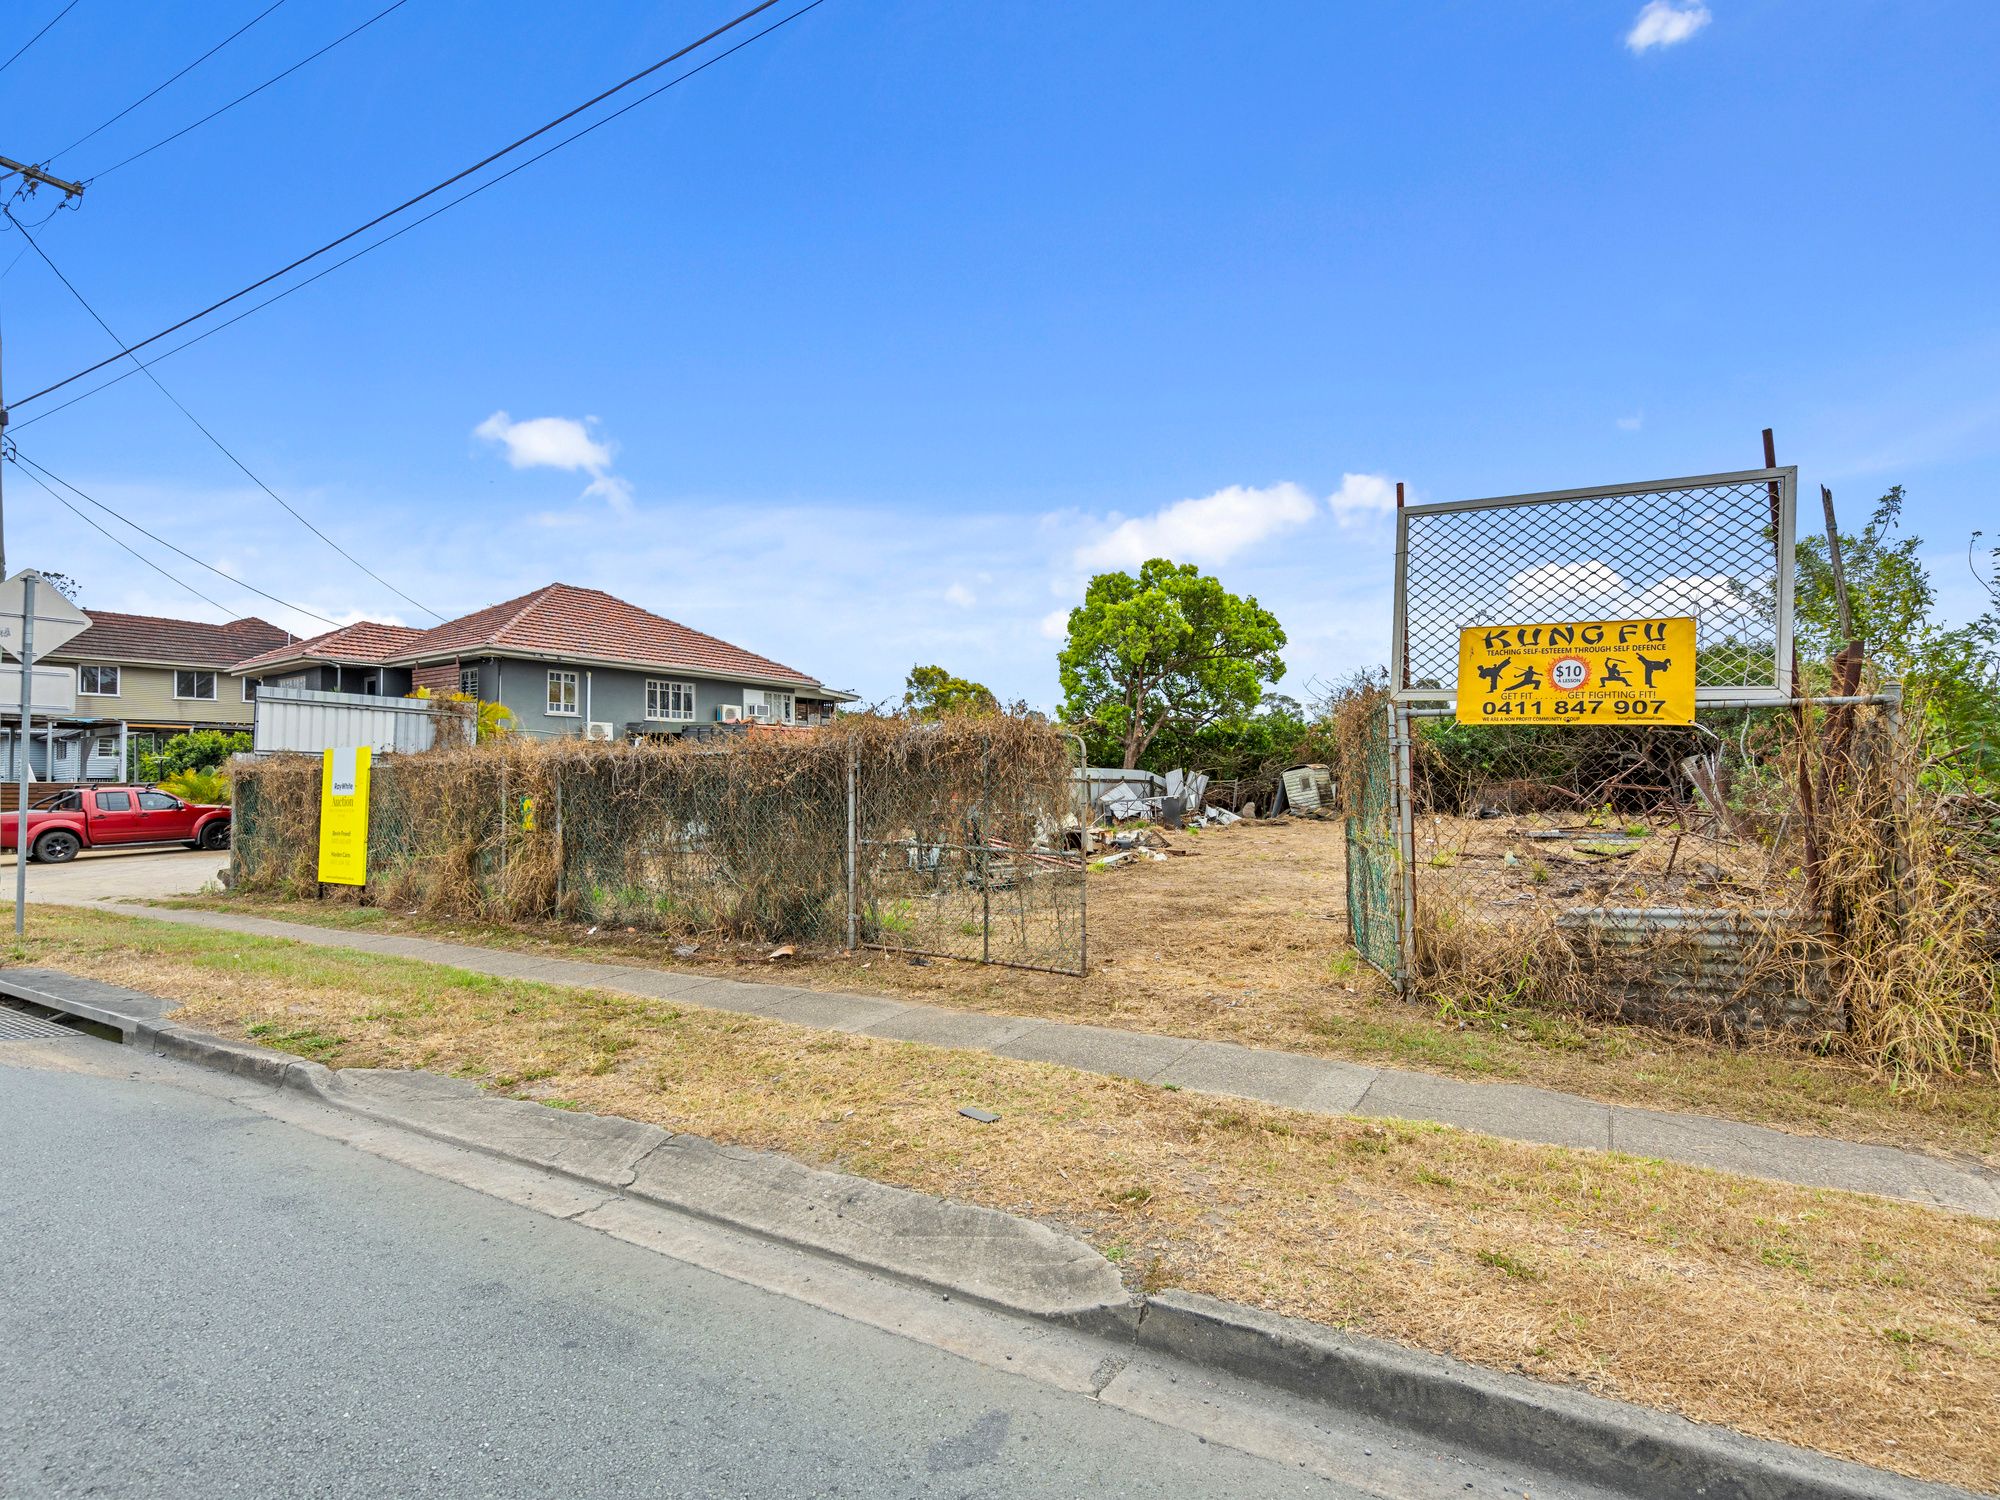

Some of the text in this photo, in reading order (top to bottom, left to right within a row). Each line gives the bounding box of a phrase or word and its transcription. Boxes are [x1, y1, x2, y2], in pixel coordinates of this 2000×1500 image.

[1482, 622, 1667, 649] KUNG FU
[1487, 648, 1521, 656] TEACHING
[1523, 647, 1572, 655] SELF-ESTEEEM
[1556, 665, 1582, 678] $10
[1501, 692, 1518, 700] GET
[1520, 692, 1533, 700] FIT
[1589, 691, 1636, 699] FIGHTING
[1639, 690, 1656, 699] FIT!
[1482, 700, 1666, 715] 0411 847 907
